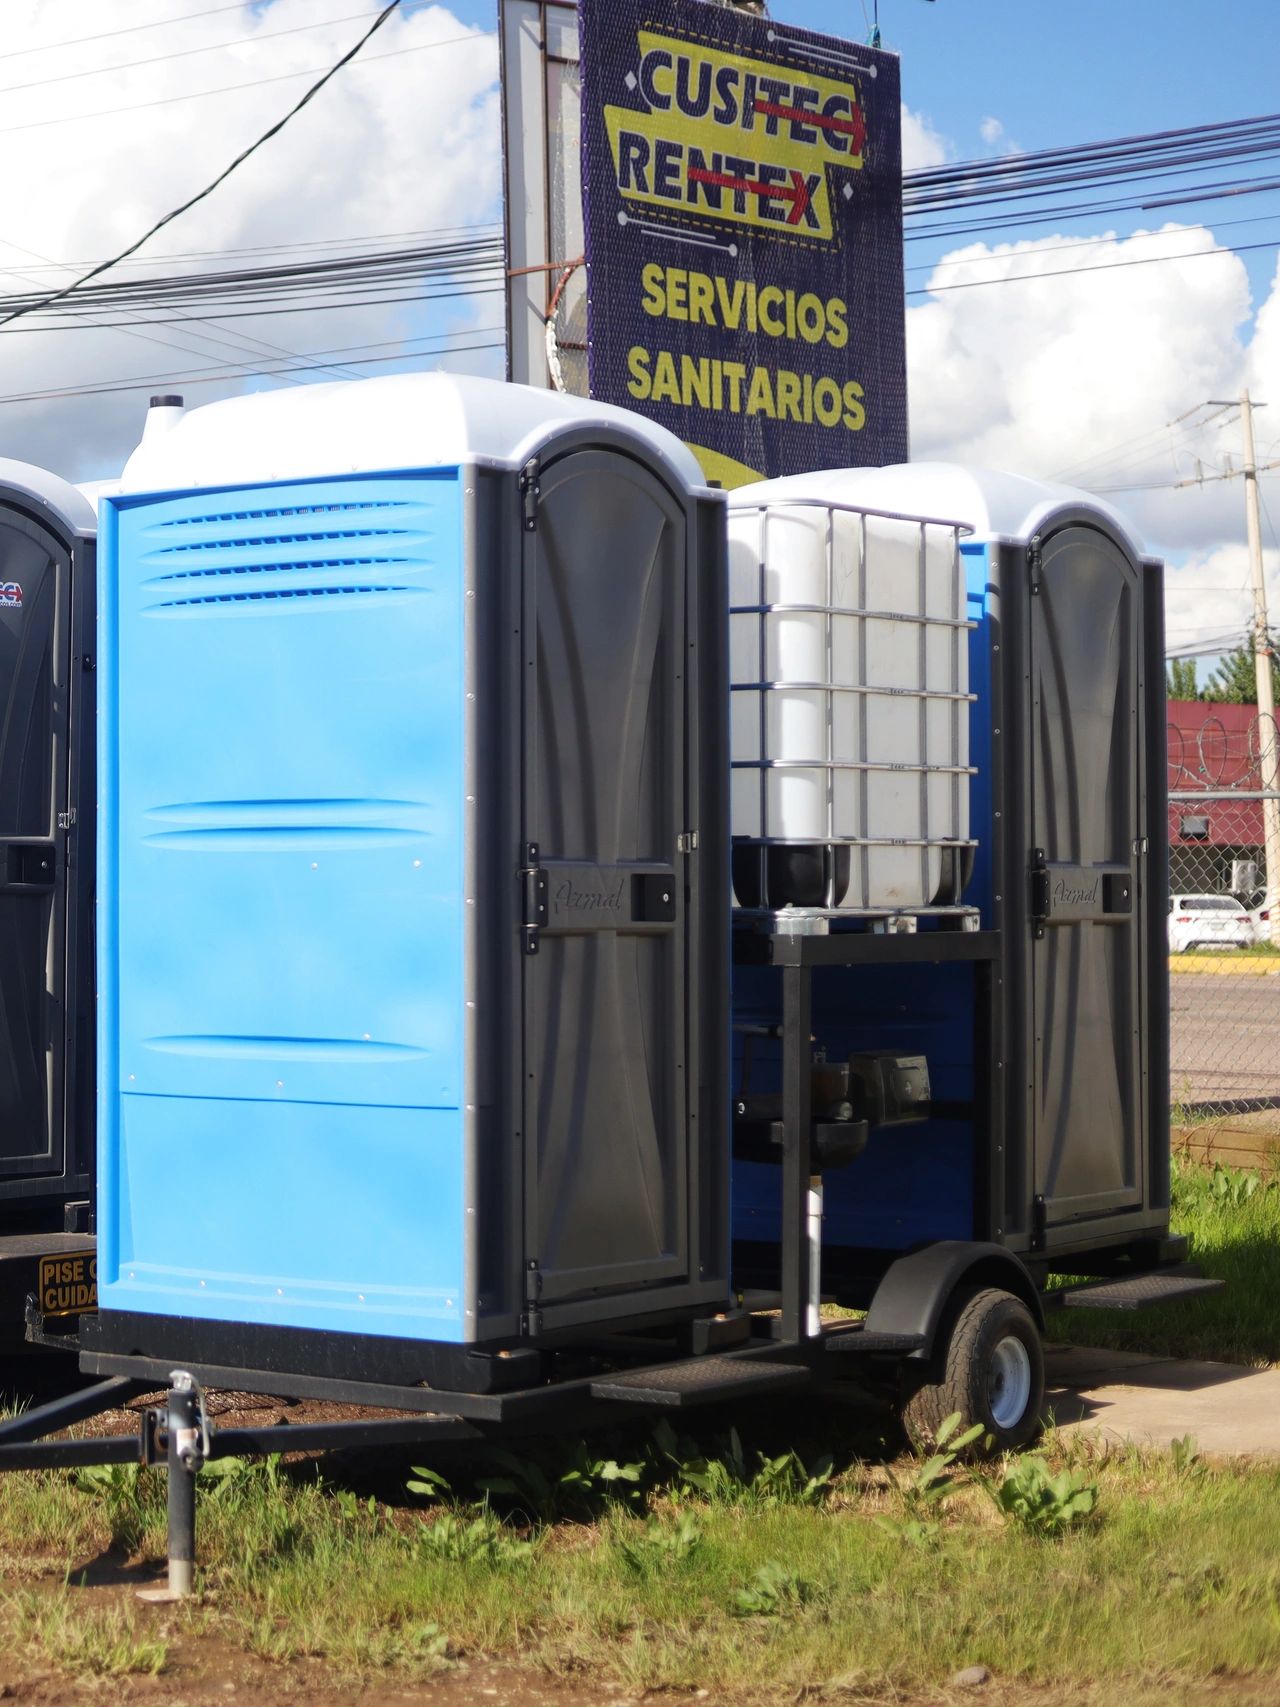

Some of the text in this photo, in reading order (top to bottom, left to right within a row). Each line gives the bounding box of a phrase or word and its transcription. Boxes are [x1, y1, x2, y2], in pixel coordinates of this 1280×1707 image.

[639, 48, 858, 154] CUSITEC
[618, 129, 822, 230] RENTEX
[641, 262, 849, 348] SERVICIOS
[627, 345, 866, 431] SANITARIOS
[553, 878, 625, 914] Armal
[1053, 877, 1099, 907] Armal
[44, 1260, 84, 1285] PISE
[45, 1283, 98, 1309] CUIDA
